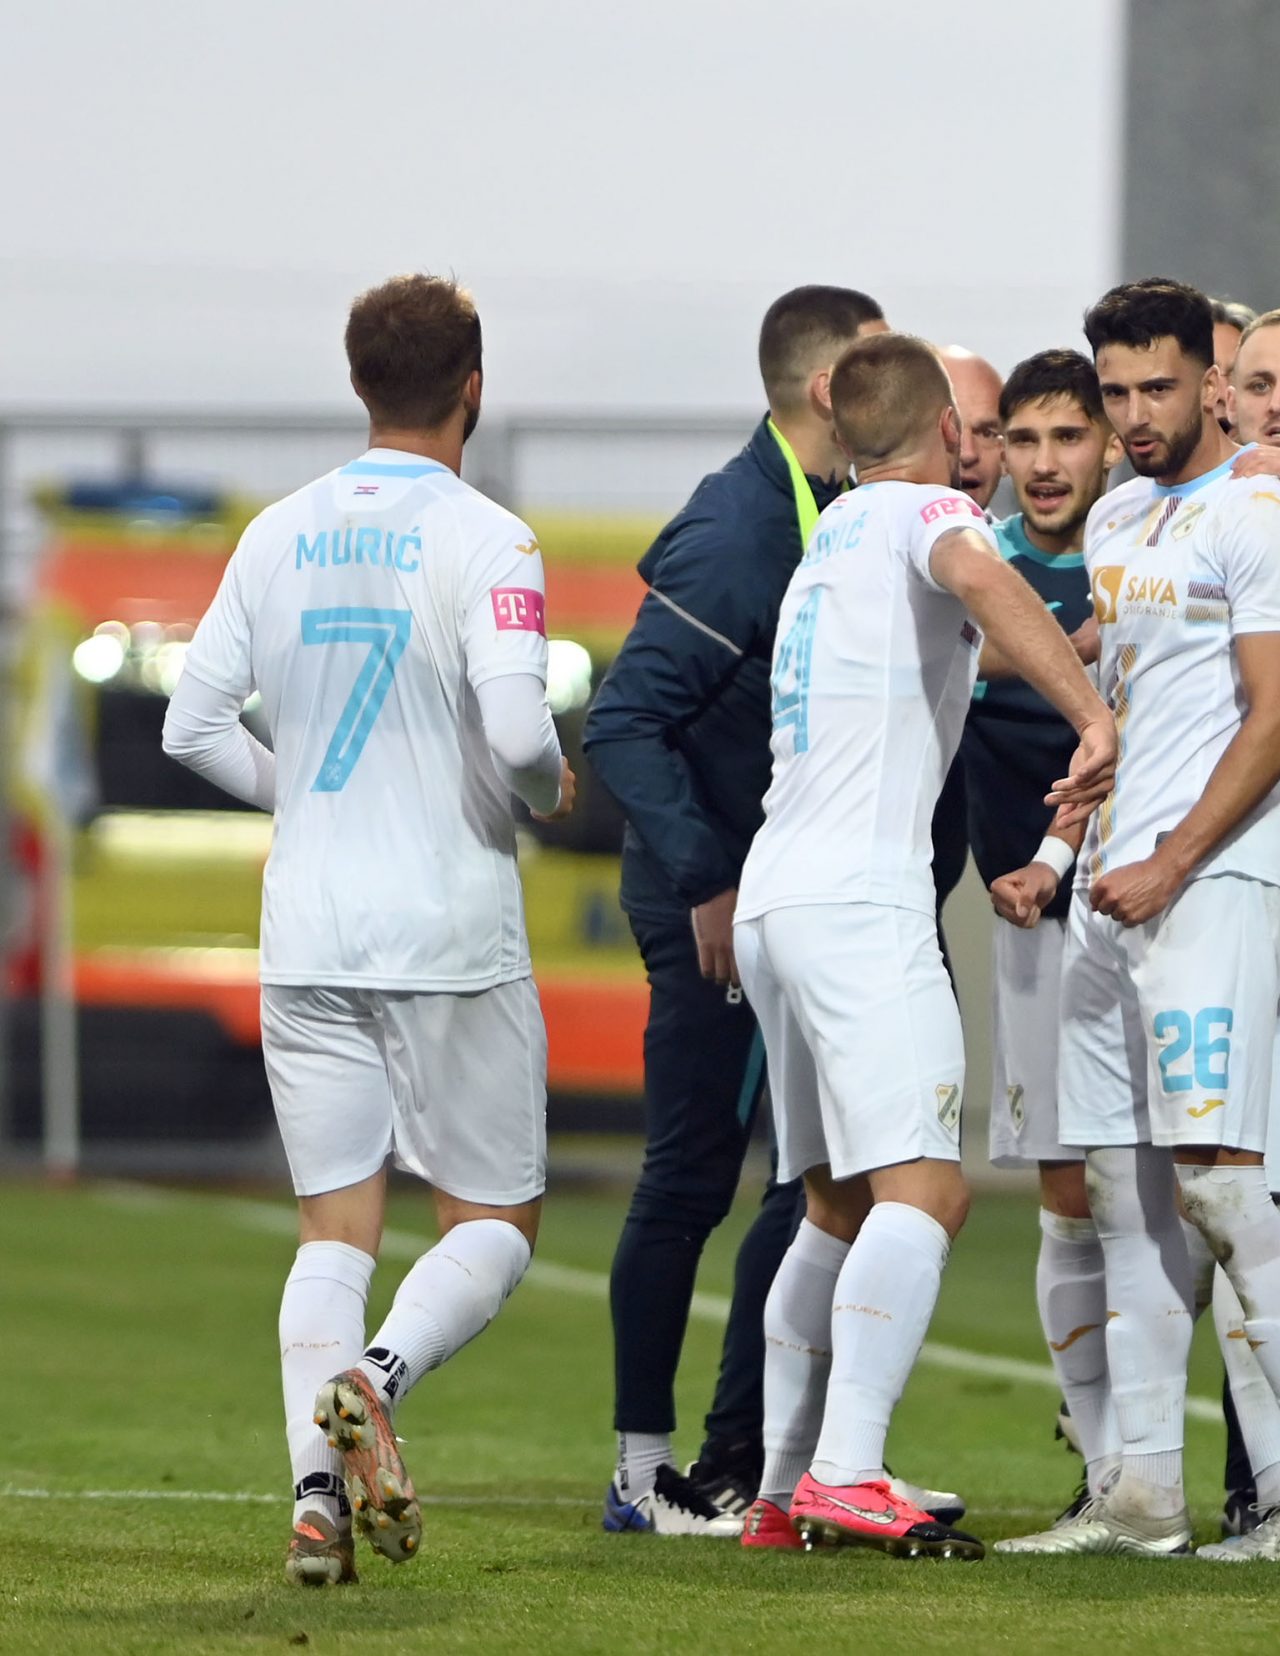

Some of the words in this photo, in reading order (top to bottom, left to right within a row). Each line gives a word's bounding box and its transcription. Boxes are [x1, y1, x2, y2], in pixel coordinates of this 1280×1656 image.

[296, 526, 422, 573] MURIĆ
[1125, 575, 1178, 607] SAVA
[301, 607, 412, 792] 7
[1154, 1006, 1234, 1093] 26
